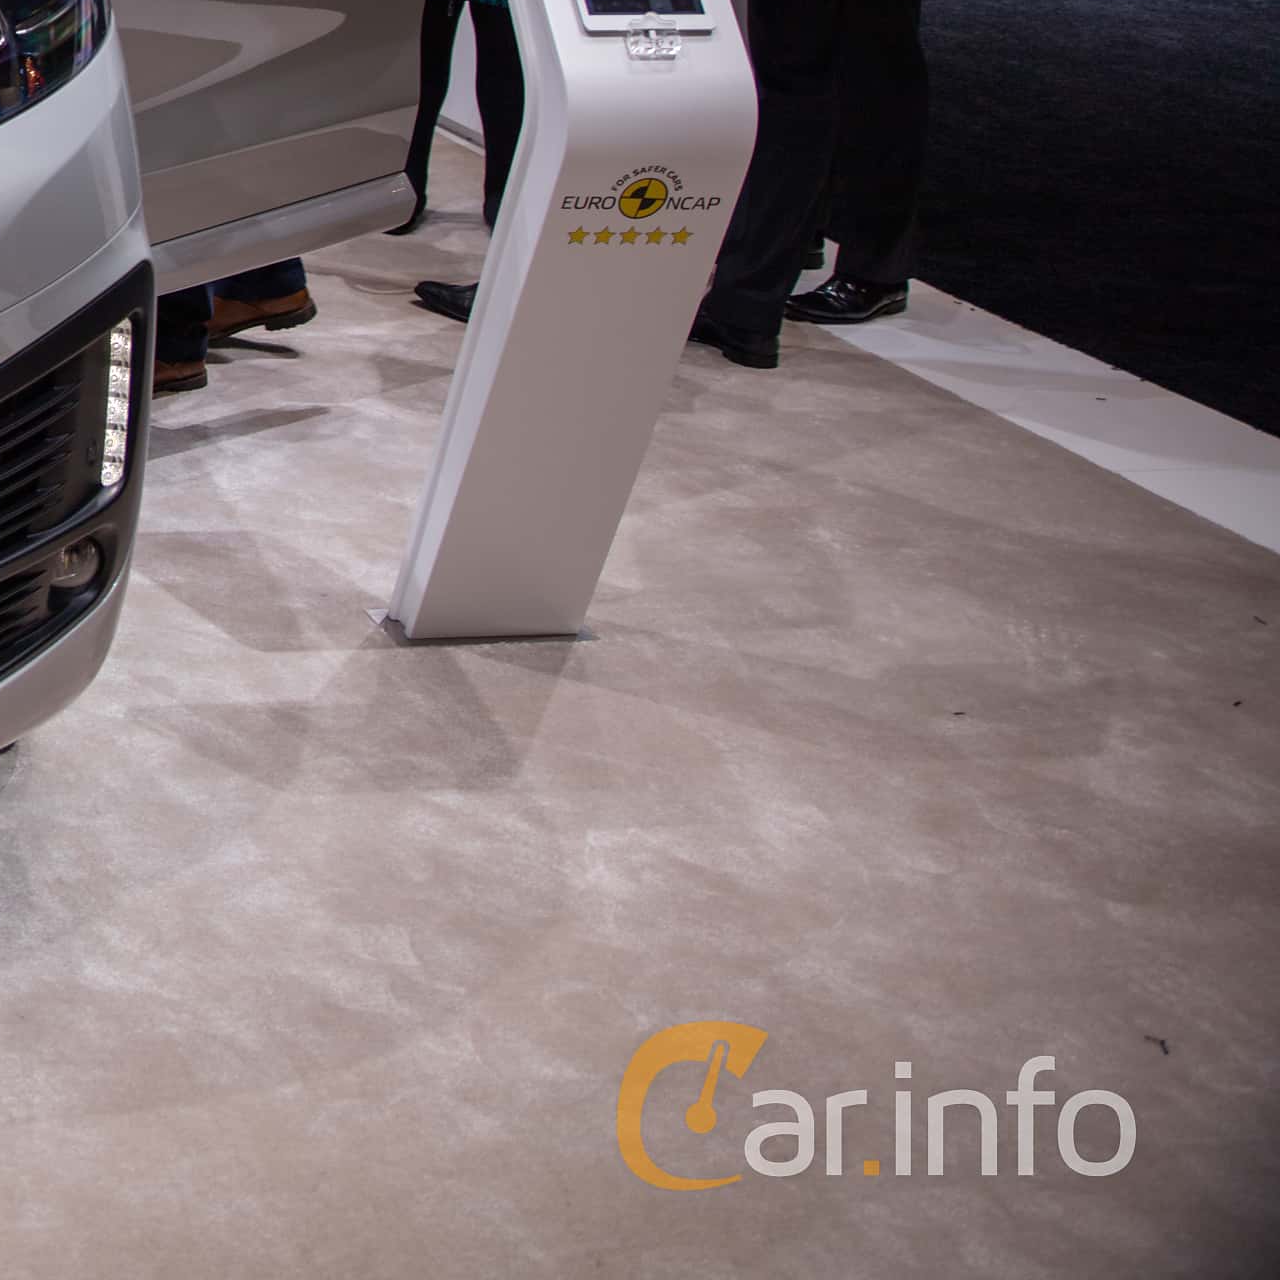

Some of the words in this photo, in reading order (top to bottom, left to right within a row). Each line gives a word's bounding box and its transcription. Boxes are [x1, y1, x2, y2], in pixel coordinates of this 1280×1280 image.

[611, 174, 631, 192] FOR
[632, 165, 667, 177] SAFER
[666, 170, 684, 192] CARS
[560, 195, 617, 210] EURO
[665, 196, 721, 211] NCAP
